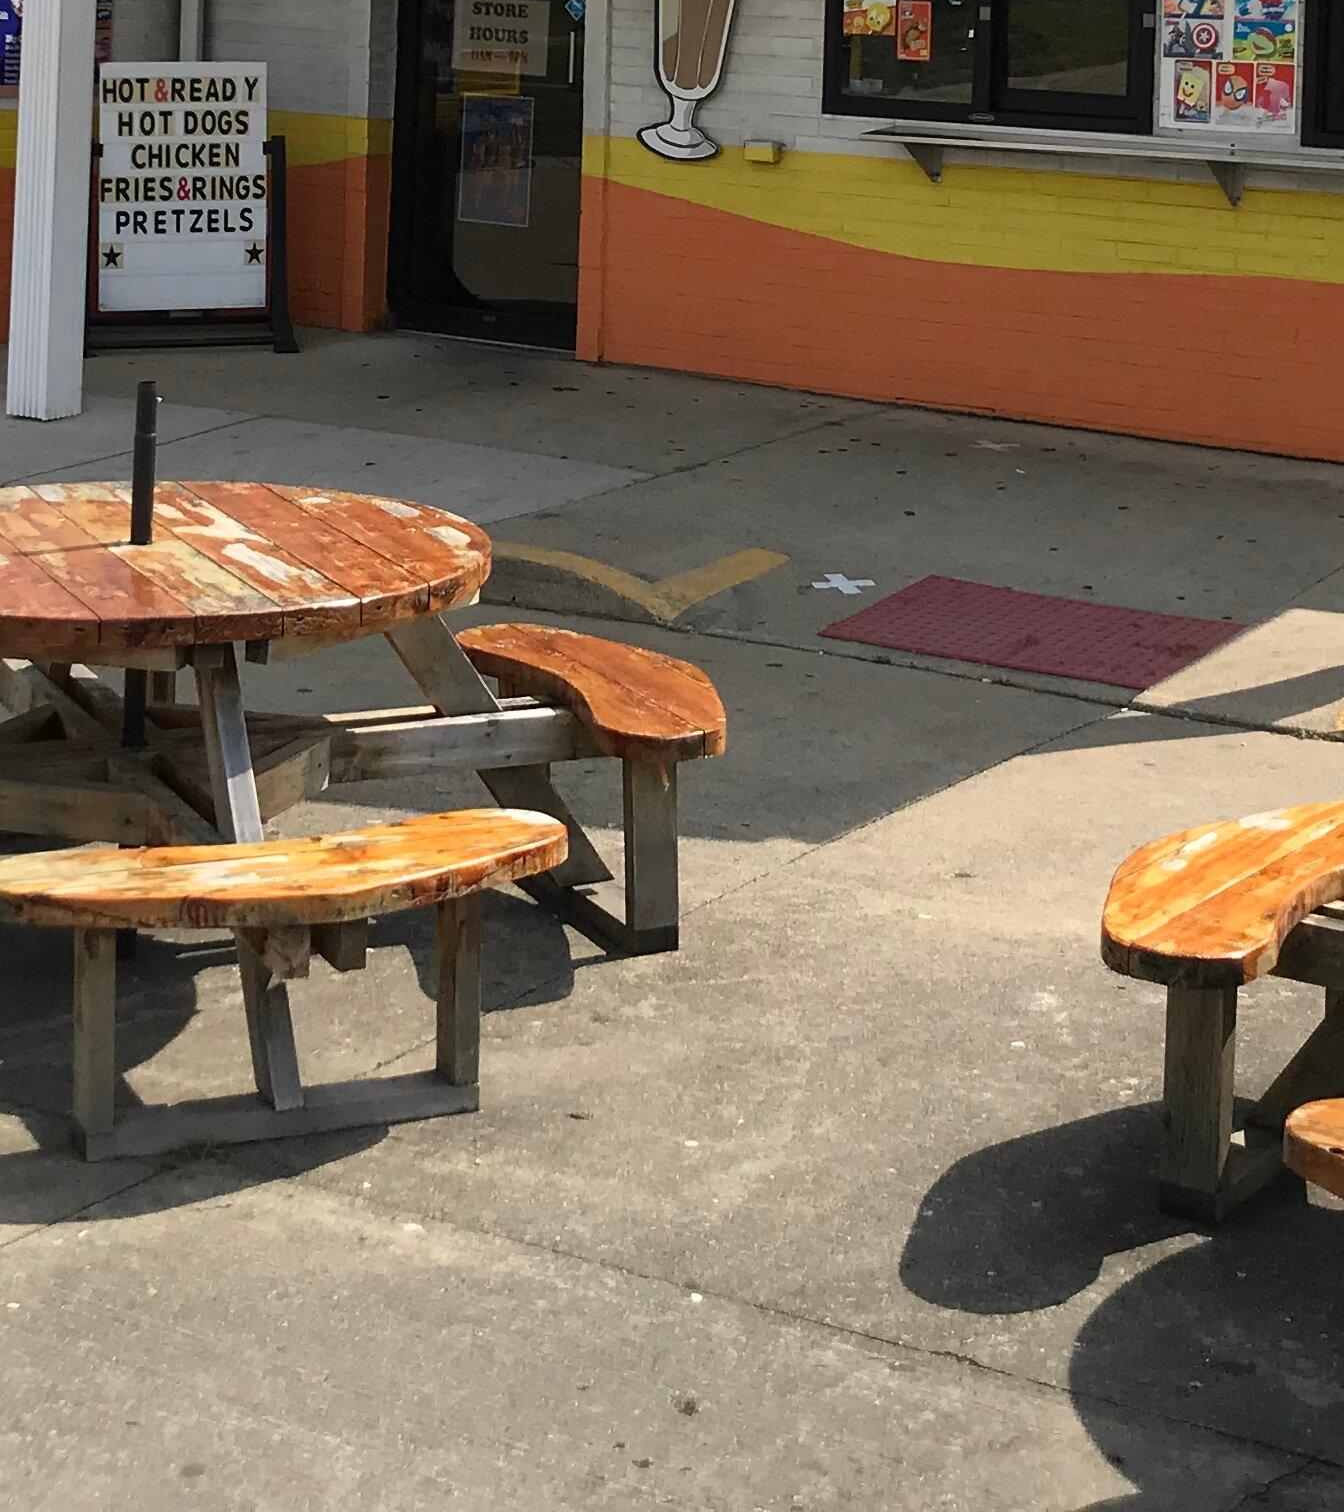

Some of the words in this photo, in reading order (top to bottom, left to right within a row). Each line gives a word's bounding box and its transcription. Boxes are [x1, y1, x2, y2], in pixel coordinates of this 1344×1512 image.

[472, 1, 529, 19] STORE
[469, 26, 529, 45] HOURS
[117, 110, 173, 136] HOT
[184, 109, 250, 135] DOGS
[131, 142, 240, 170] CHICKEN
[115, 207, 254, 235] PRETZELS
